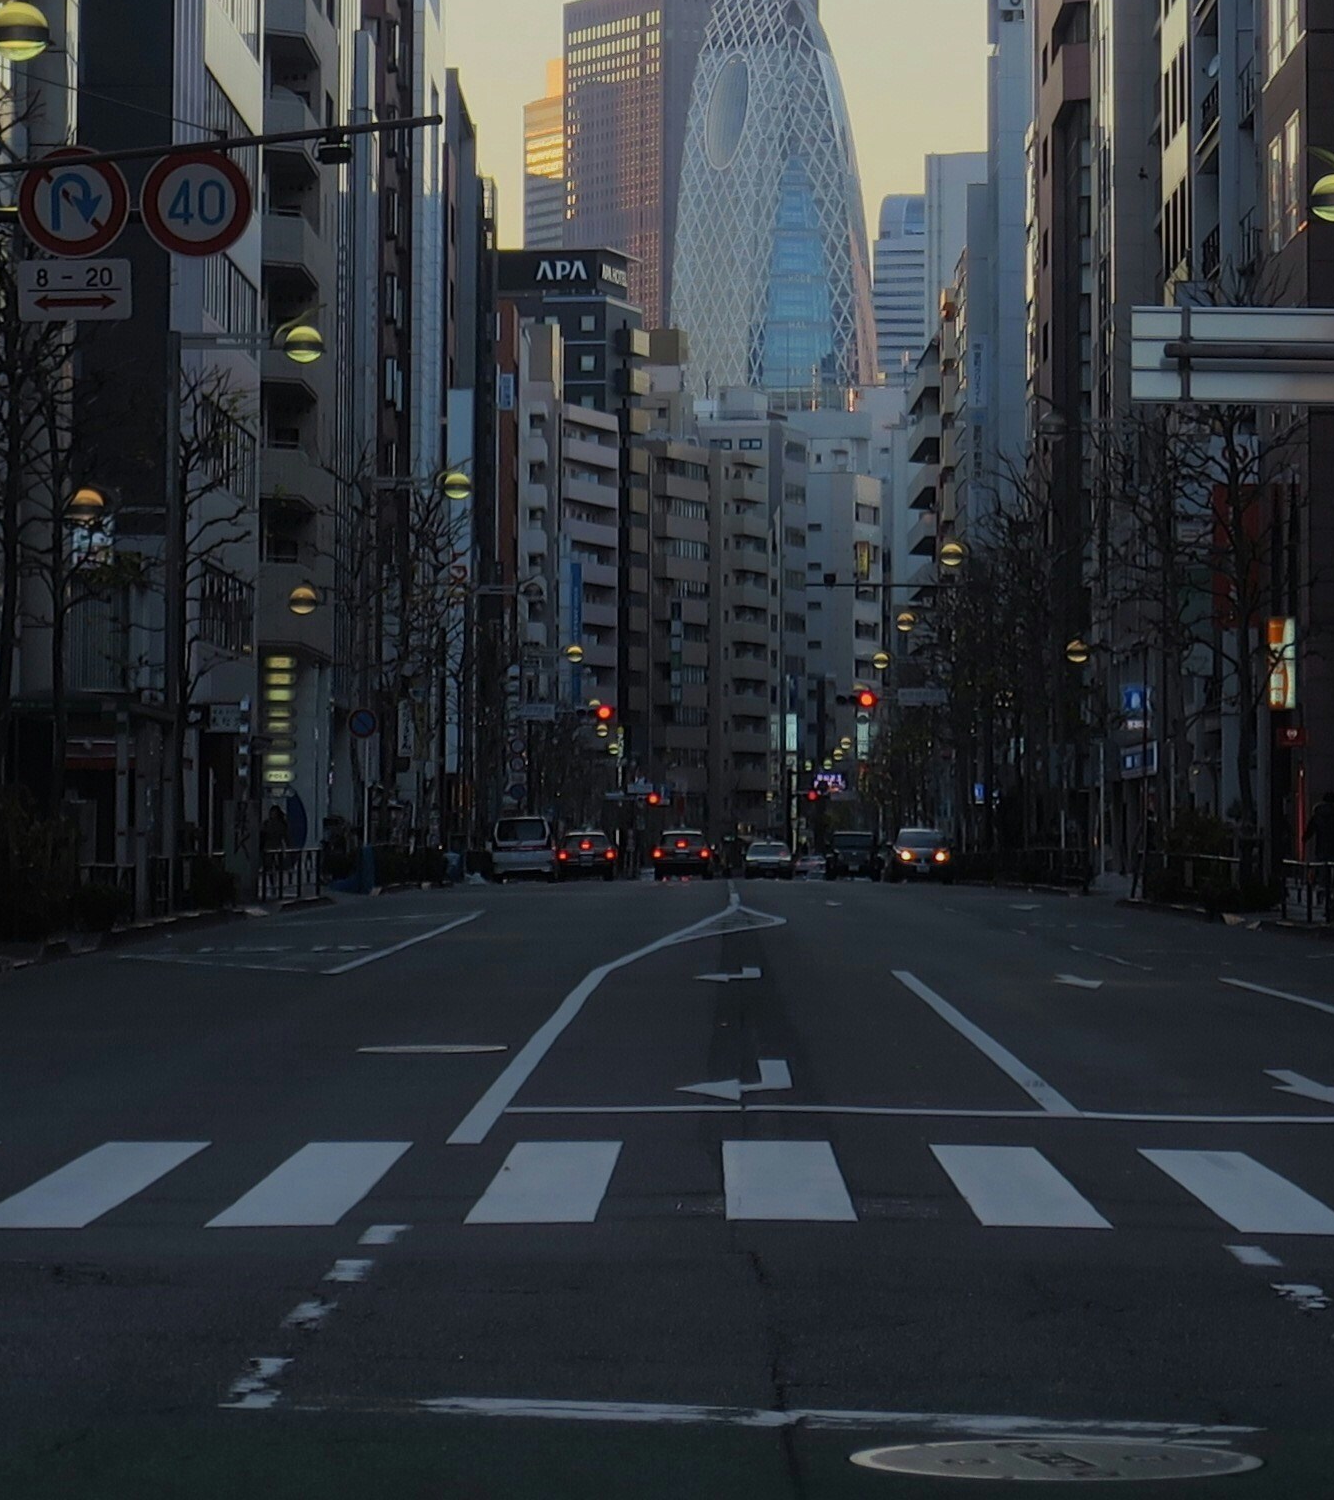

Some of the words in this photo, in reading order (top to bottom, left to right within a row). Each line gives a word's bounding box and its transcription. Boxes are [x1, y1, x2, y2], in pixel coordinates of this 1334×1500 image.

[168, 178, 226, 226] 40
[36, 269, 49, 288] 8
[85, 268, 119, 288] 20
[535, 260, 588, 281] APA
